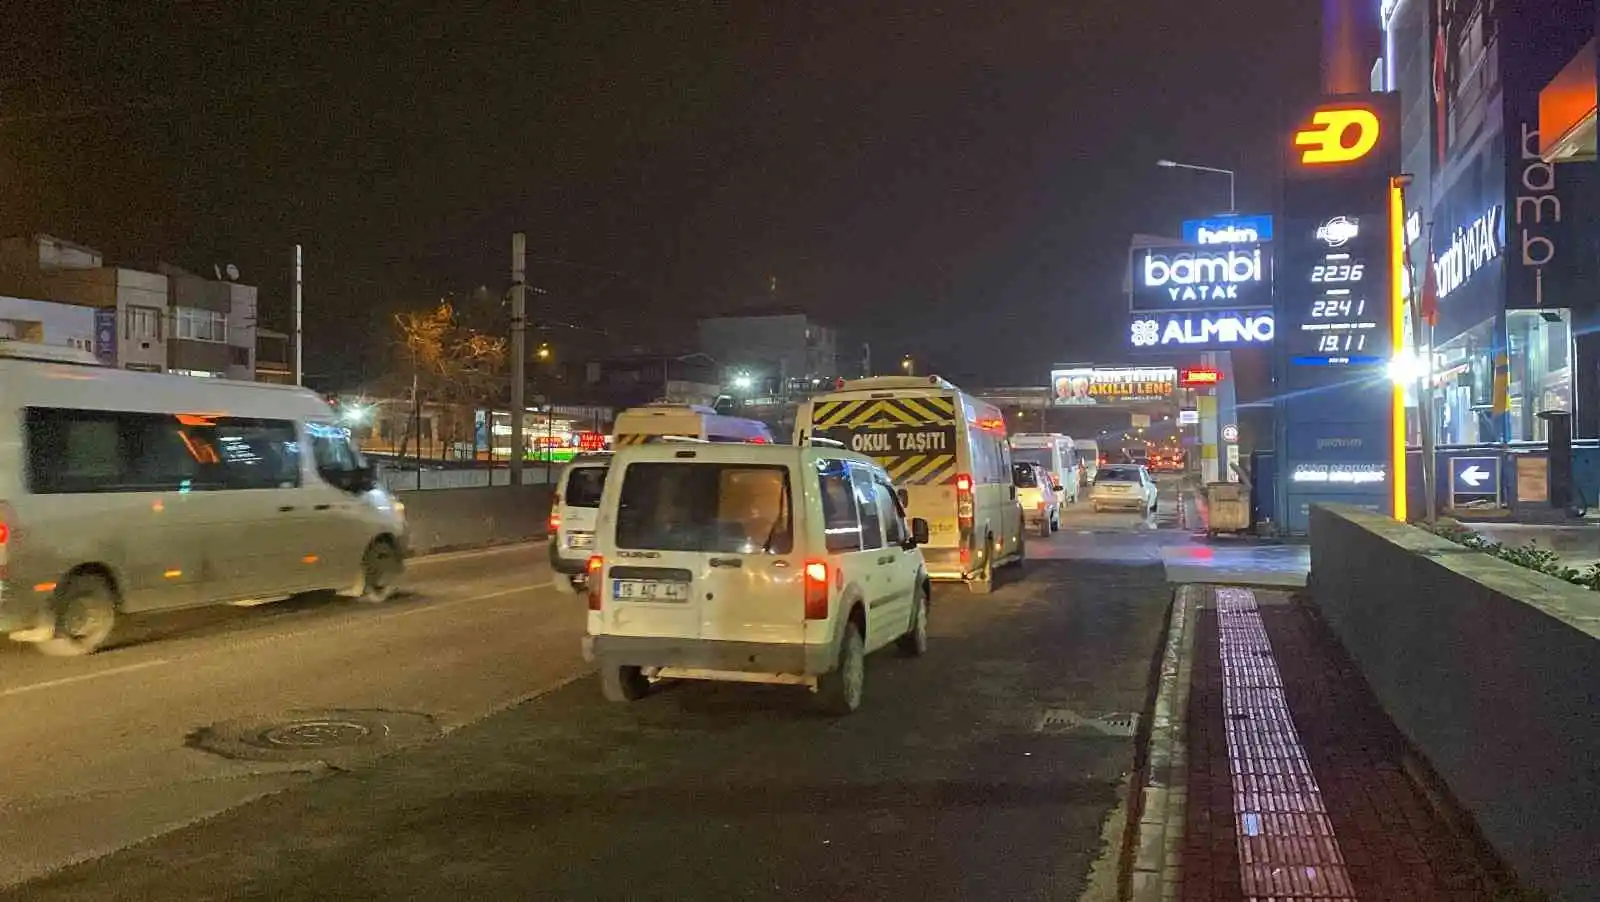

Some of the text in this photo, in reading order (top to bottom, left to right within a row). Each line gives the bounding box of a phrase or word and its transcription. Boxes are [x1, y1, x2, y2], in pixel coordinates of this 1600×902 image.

[1463, 205, 1496, 277] YATAK
[1145, 249, 1261, 286] bambi
[1168, 285, 1238, 301] YATAK
[1089, 383, 1132, 395] AKILLI
[852, 433, 892, 452] OKUL
